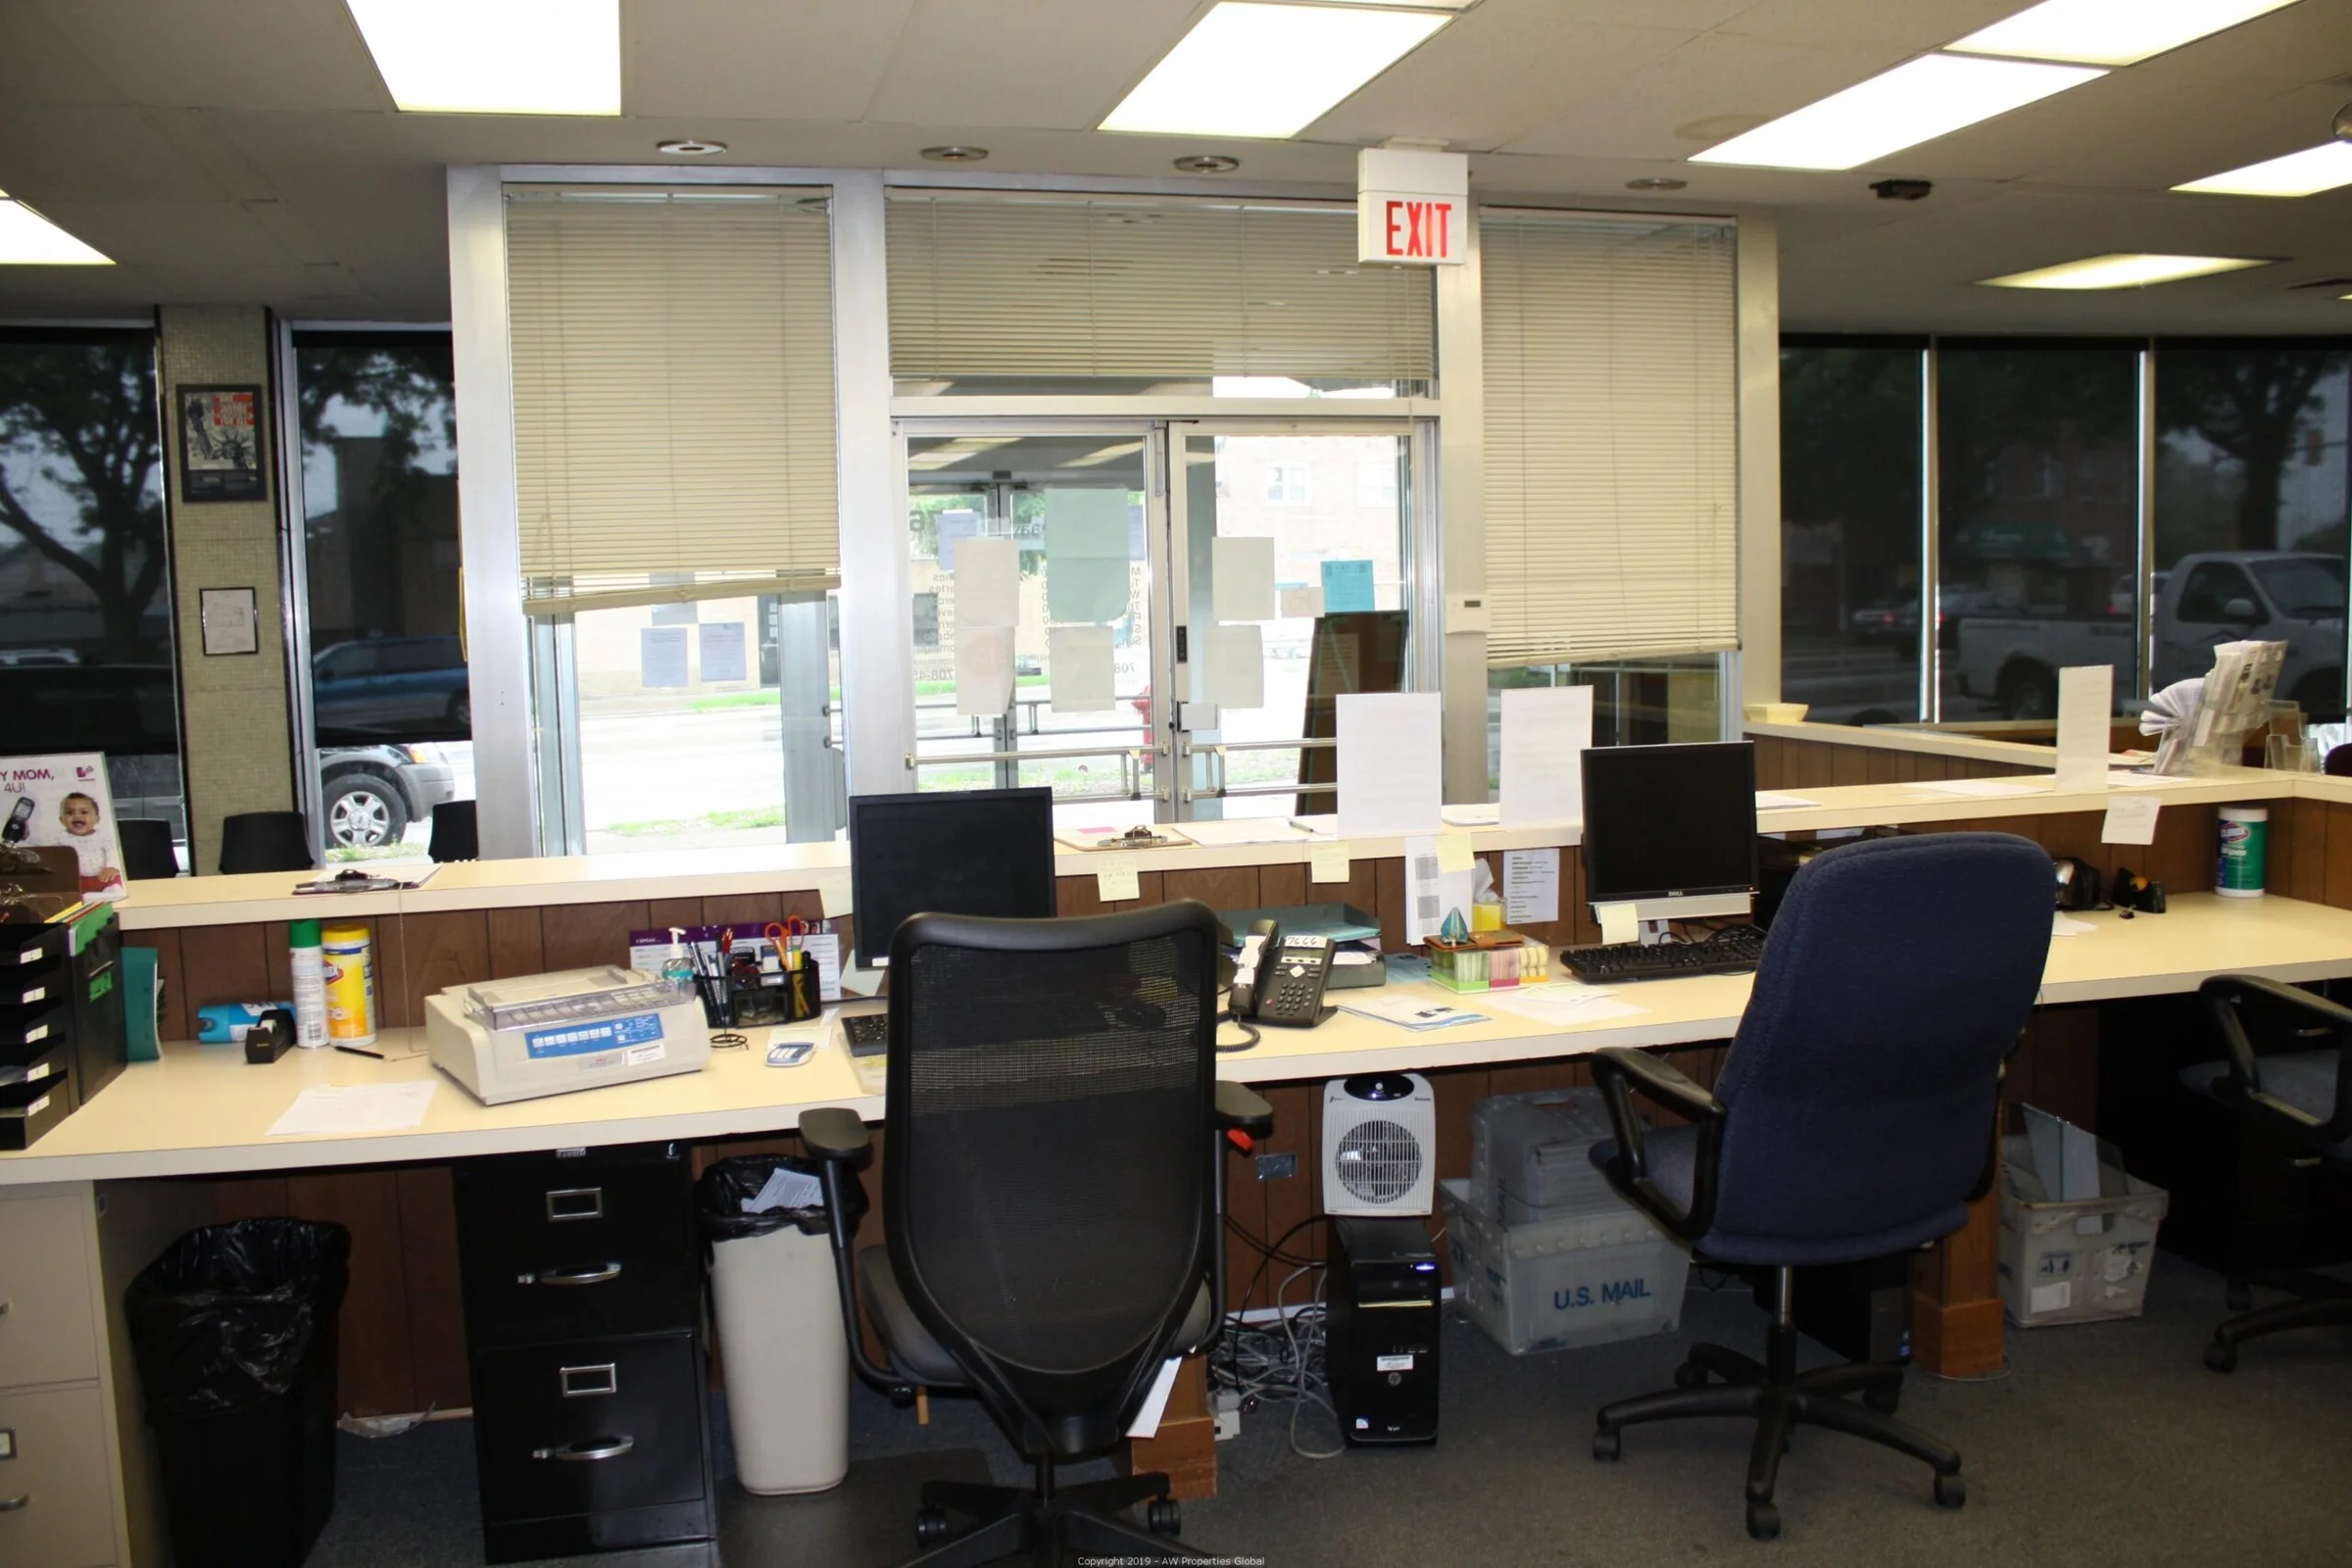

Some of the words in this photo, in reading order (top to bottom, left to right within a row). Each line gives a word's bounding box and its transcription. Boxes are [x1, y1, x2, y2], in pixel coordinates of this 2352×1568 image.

[1386, 200, 1452, 258] EXIT
[13, 768, 55, 781] MOM,
[4, 782, 25, 794] 4U!
[1287, 936, 1318, 946] 7666
[1554, 1287, 1594, 1309] U.S.
[1601, 1279, 1651, 1302] MAIL
